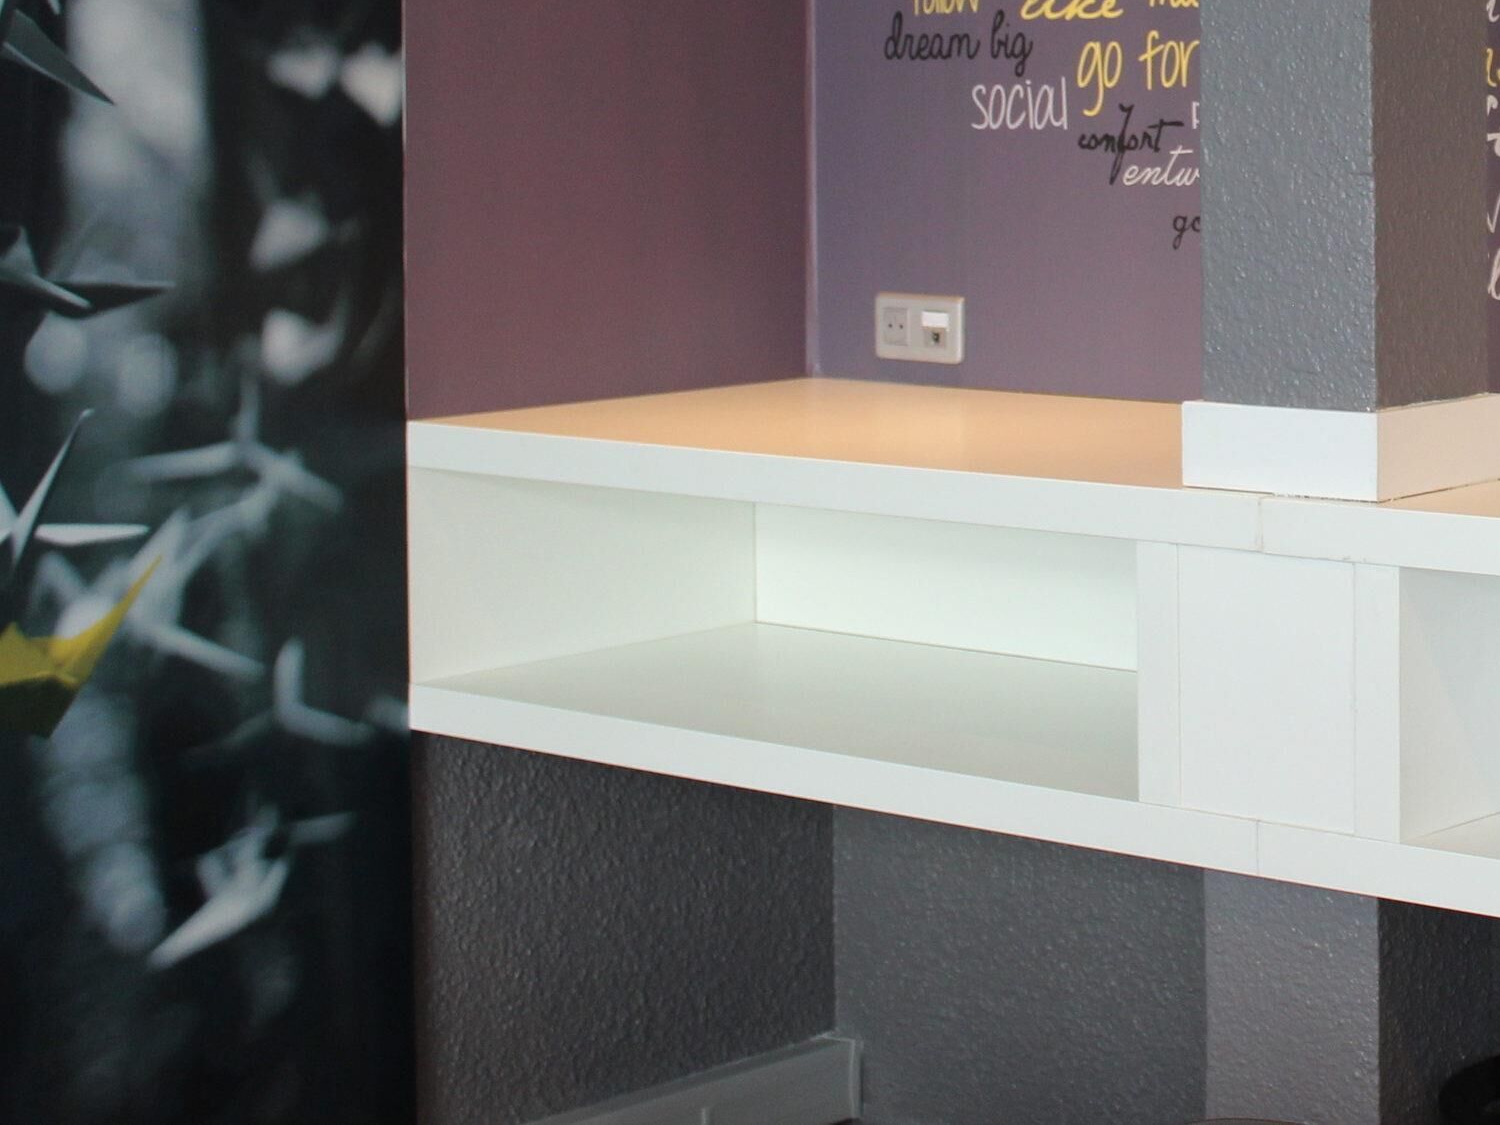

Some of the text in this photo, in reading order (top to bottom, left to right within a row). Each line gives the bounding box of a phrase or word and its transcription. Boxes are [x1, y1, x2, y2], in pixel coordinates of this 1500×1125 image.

[884, 9, 1034, 77] dream big
[971, 76, 1068, 130] social
[1077, 39, 1124, 117] go
